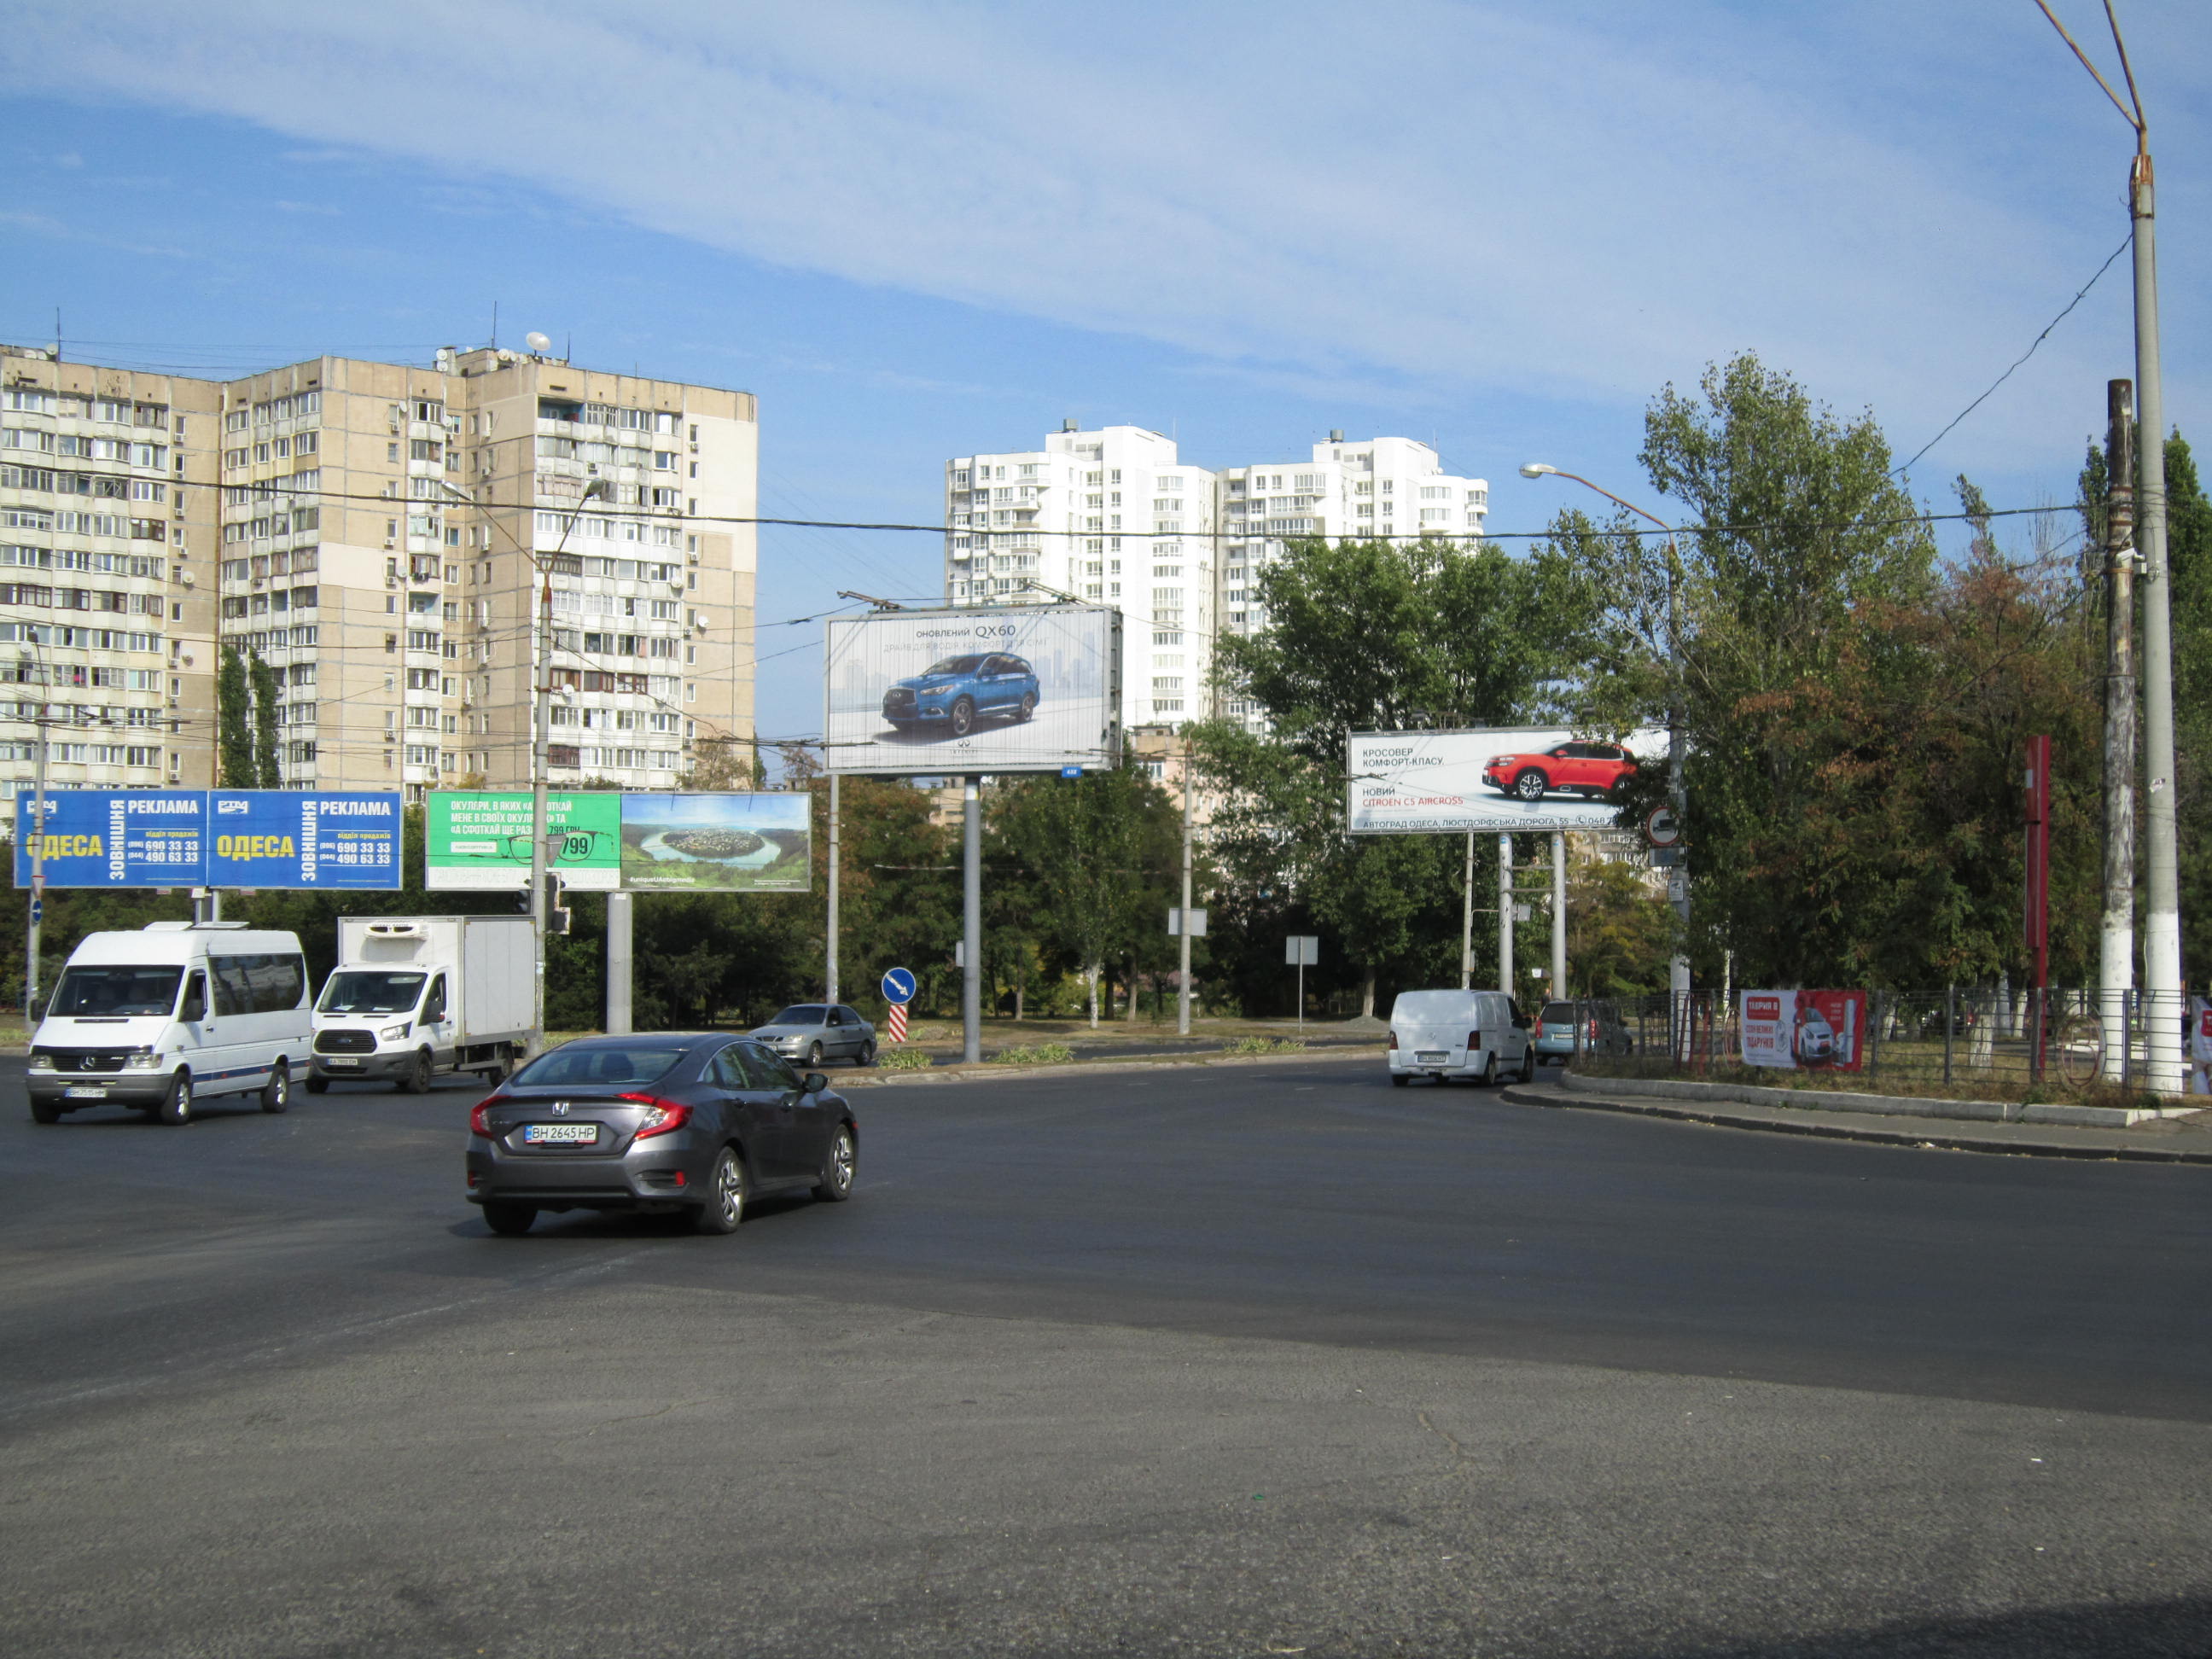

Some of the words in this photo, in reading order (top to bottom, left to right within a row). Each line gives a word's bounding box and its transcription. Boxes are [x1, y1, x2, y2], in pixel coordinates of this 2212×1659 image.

[916, 628, 970, 638] ОНОВЛЕНИЙ
[1363, 748, 1413, 758] КРОСОВЕР
[1363, 757, 1445, 767] КОМФОРТ-КЛАСУ.
[1363, 788, 1395, 796] НОВИЙ
[128, 800, 198, 813] РЕКЛАМА
[493, 801, 498, 811] В
[500, 801, 521, 811] ЯКИХ
[1417, 796, 1464, 806] AIRCROSS
[320, 801, 391, 815] РЕКЛАМА
[451, 813, 472, 823] МЕНЕ
[474, 813, 480, 823] В
[481, 812, 504, 823] СВОЇХ
[556, 813, 566, 824] ТА
[1410, 820, 1441, 829] ОДЕСА,
[1442, 818, 1516, 829] ЛЮСТДОРФСЬКА
[1519, 818, 1557, 827] ДОРОГА,
[451, 825, 461, 835] «А
[462, 824, 500, 835] СФОТКАЙ
[109, 800, 125, 880] ЗОВНІШНЯ
[301, 800, 317, 882] ЗОВНІШНЯ
[146, 841, 166, 851] 690
[168, 841, 182, 851] 33
[184, 841, 198, 851] 33
[217, 835, 294, 861] ОДЕСА
[337, 842, 358, 853] 690
[360, 842, 374, 853] 33
[376, 842, 390, 853] 33
[145, 853, 166, 862] 490
[168, 853, 182, 862] 63
[184, 853, 198, 862] 33
[336, 853, 358, 864] 490
[360, 854, 374, 864] 63
[376, 854, 390, 864] 33
[532, 1127, 548, 1139] BH
[550, 1127, 576, 1138] 2645
[579, 1127, 595, 1138] HP
